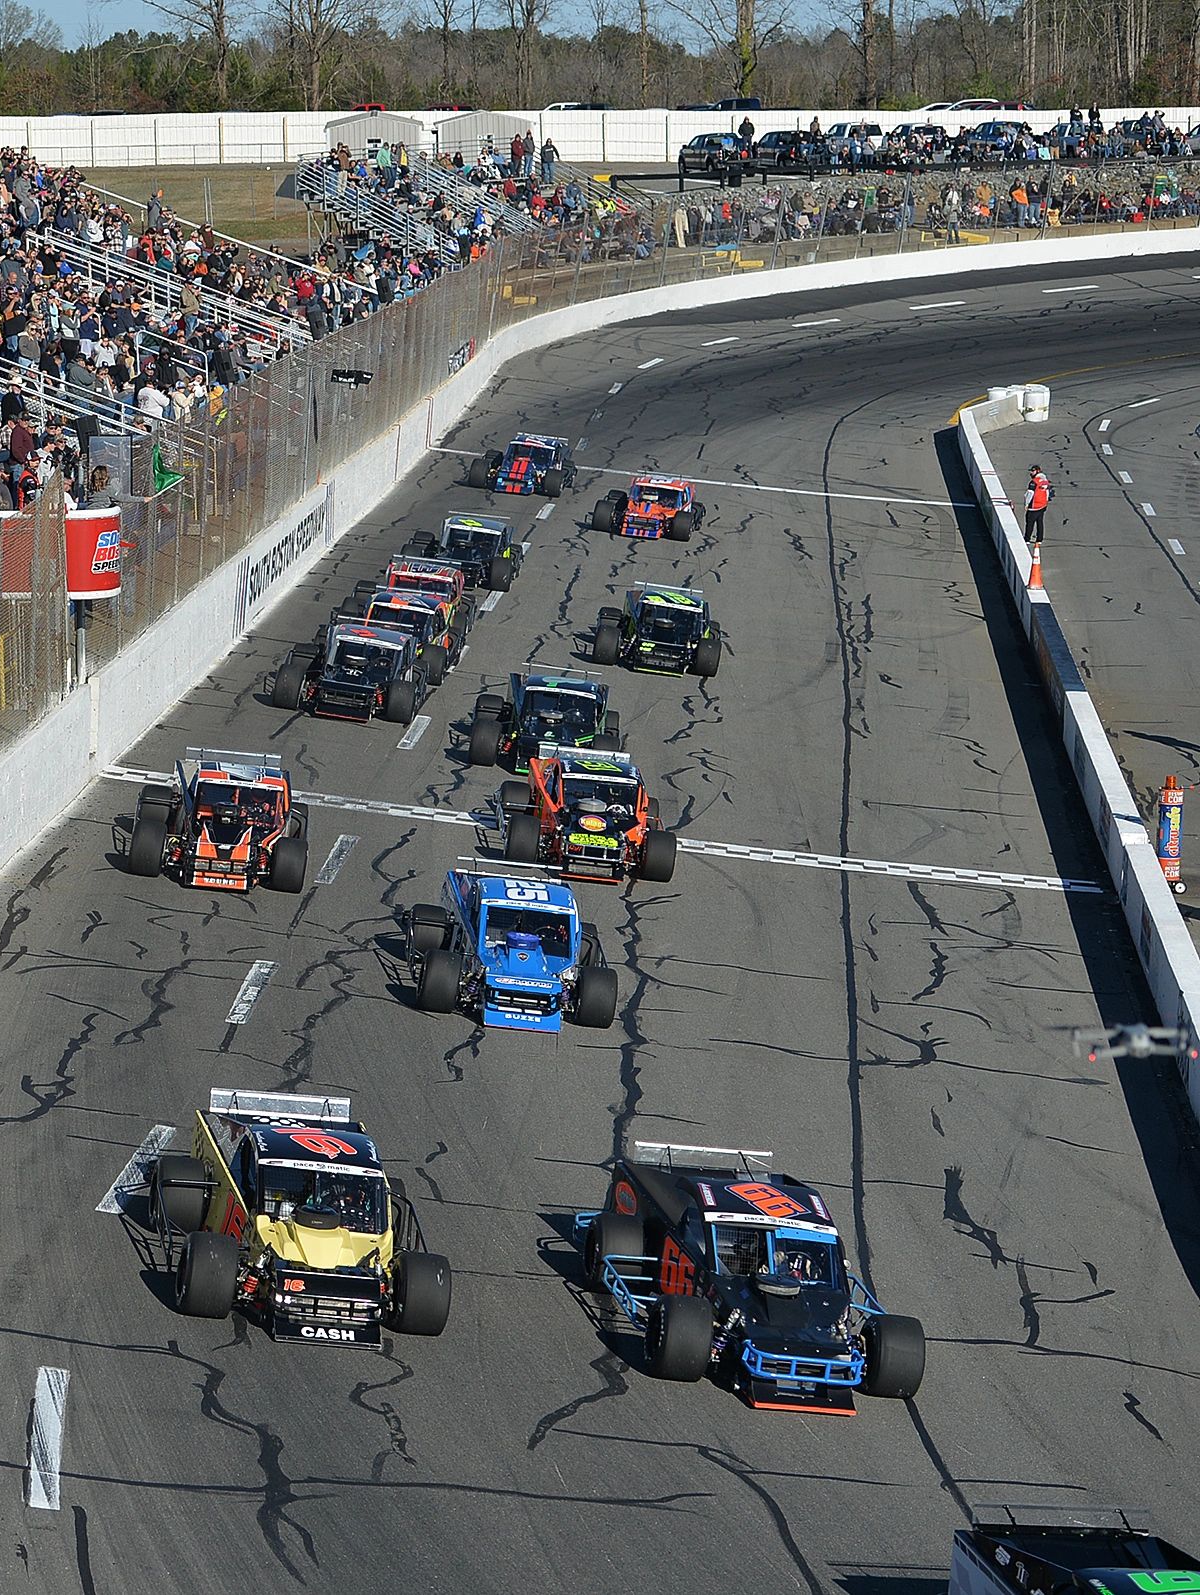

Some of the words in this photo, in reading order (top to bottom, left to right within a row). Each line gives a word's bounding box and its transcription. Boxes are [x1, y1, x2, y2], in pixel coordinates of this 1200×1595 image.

[98, 531, 120, 548] SO
[292, 1161, 314, 1169] pace
[327, 1165, 351, 1173] matic
[725, 1182, 812, 1219] 66
[659, 1234, 698, 1297] 66
[283, 1278, 306, 1292] 16
[300, 1325, 356, 1342] CASH
